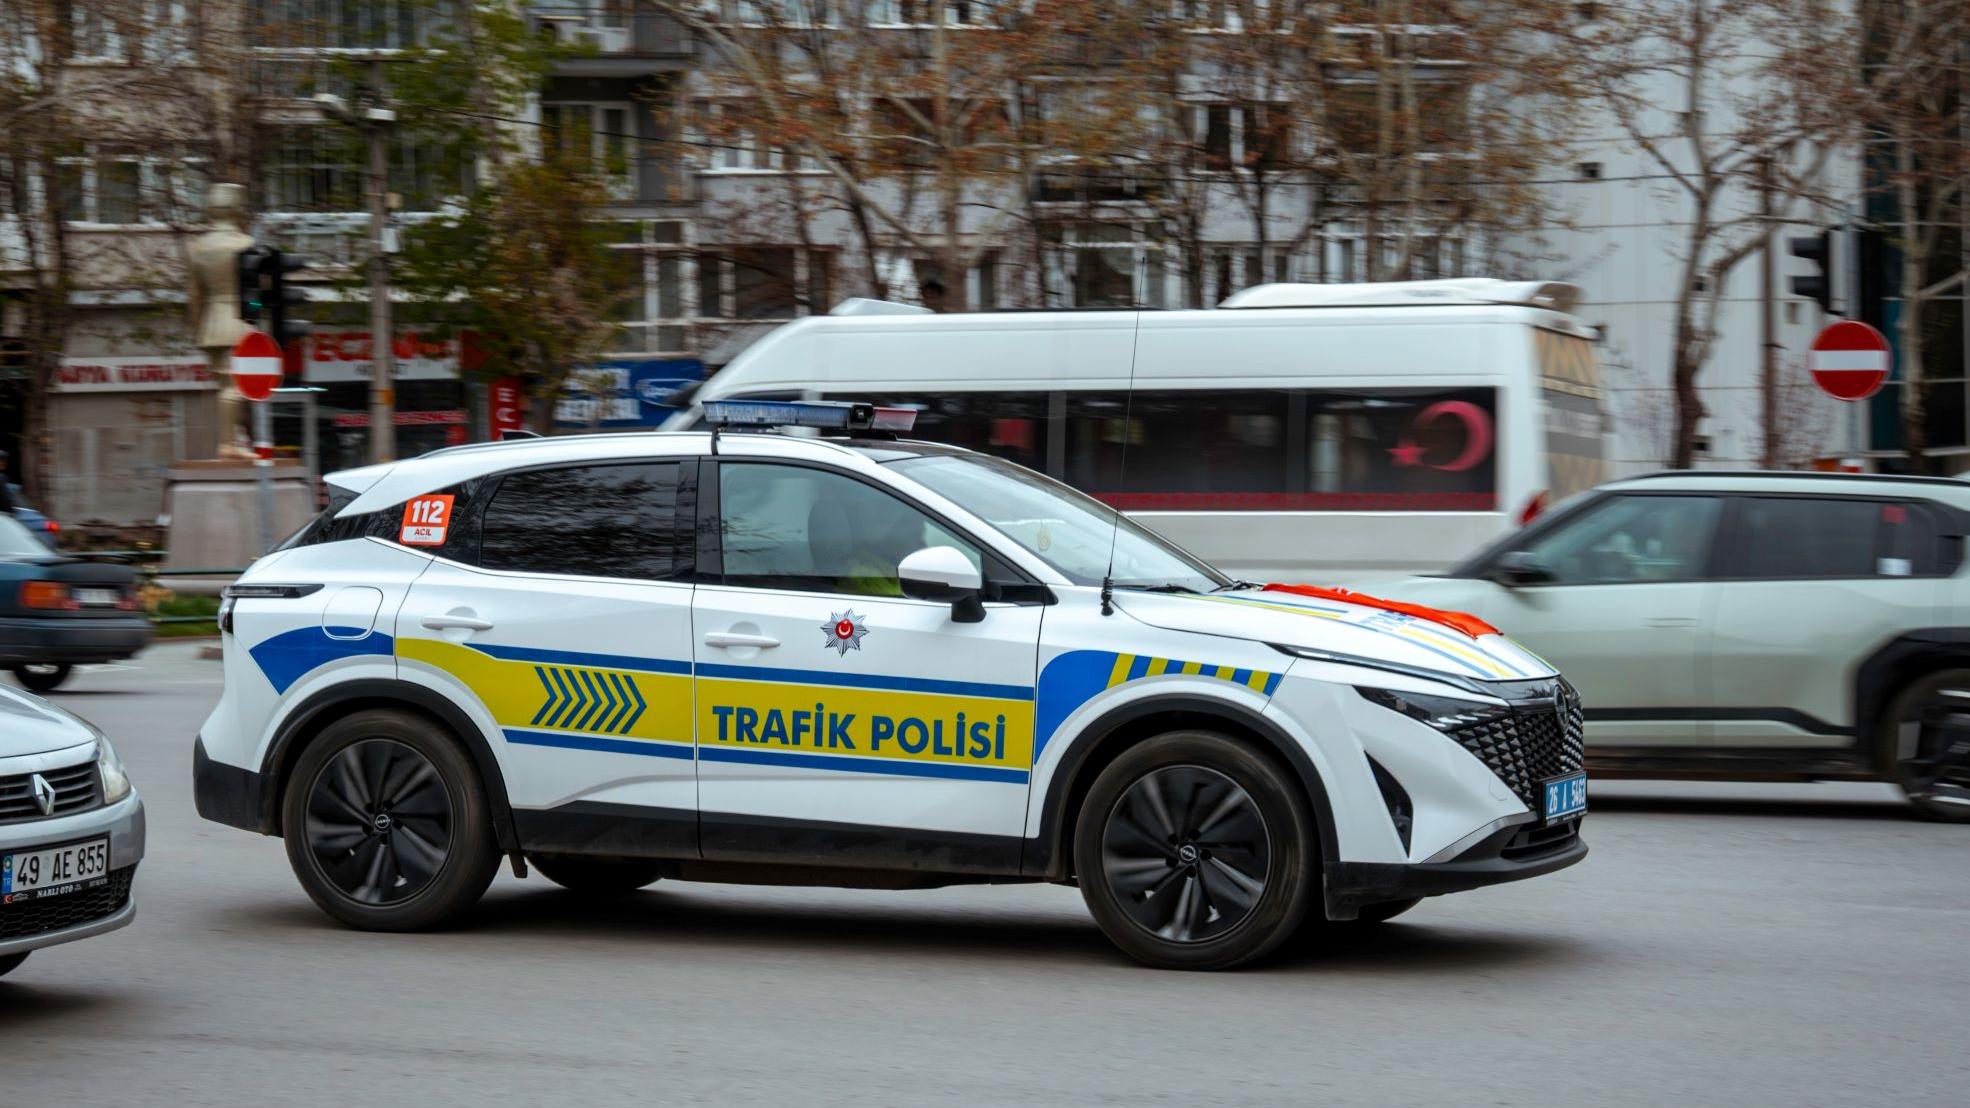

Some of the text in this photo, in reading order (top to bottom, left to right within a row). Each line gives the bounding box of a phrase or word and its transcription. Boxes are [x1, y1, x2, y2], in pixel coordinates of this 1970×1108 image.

[412, 500, 445, 524] 112
[712, 702, 1006, 760] TRAFİK POLİSİ
[17, 856, 40, 886] 49
[52, 850, 73, 881] AE
[77, 844, 105, 876] 855
[60, 884, 74, 895] OTO
